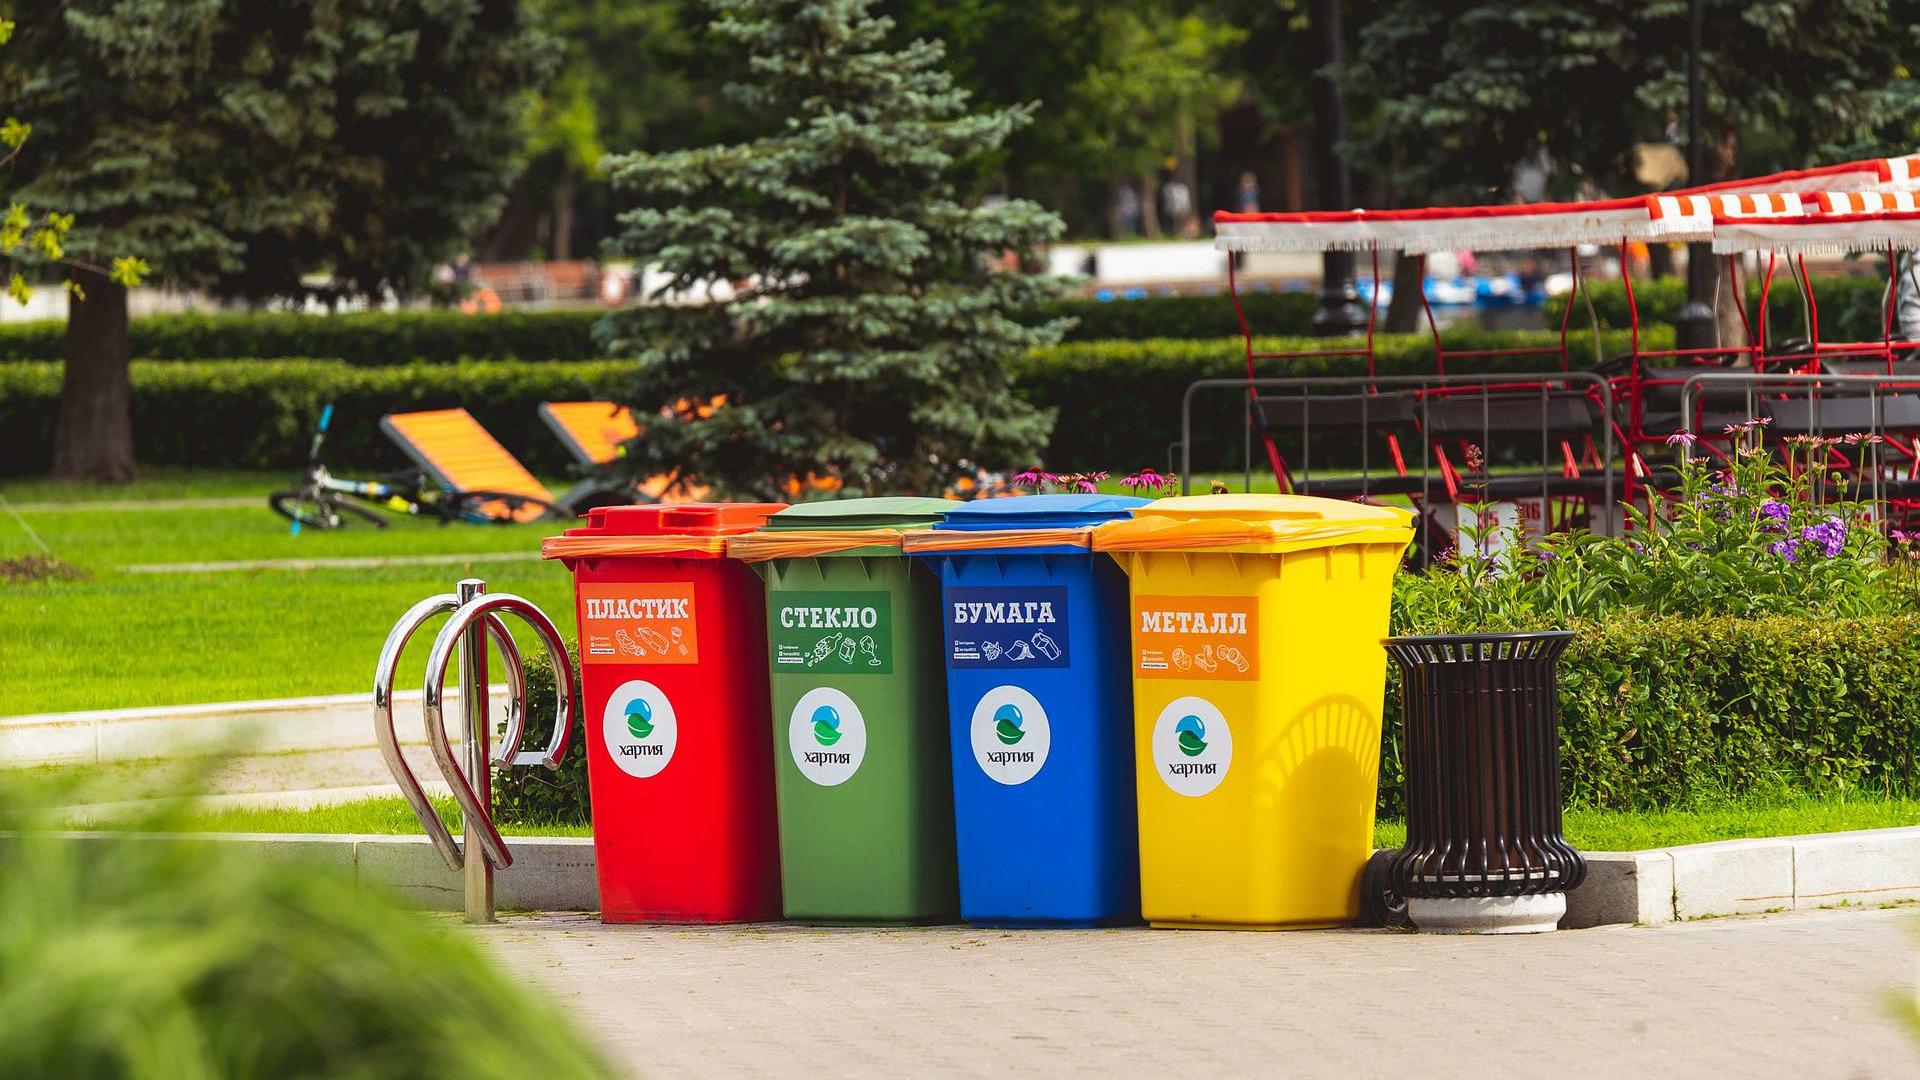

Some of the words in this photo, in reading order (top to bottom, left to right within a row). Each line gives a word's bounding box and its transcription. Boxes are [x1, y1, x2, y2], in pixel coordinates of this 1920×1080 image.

[586, 598, 689, 619] ПЛАСТИК
[780, 606, 878, 629] СТЕКЛО
[953, 602, 1056, 624] БУМАГА
[1141, 611, 1247, 635] МЕТАЛЛ
[619, 744, 664, 760] хартия
[804, 751, 851, 766] хартия
[986, 751, 1033, 765] хартия
[1168, 762, 1217, 778] хартия
